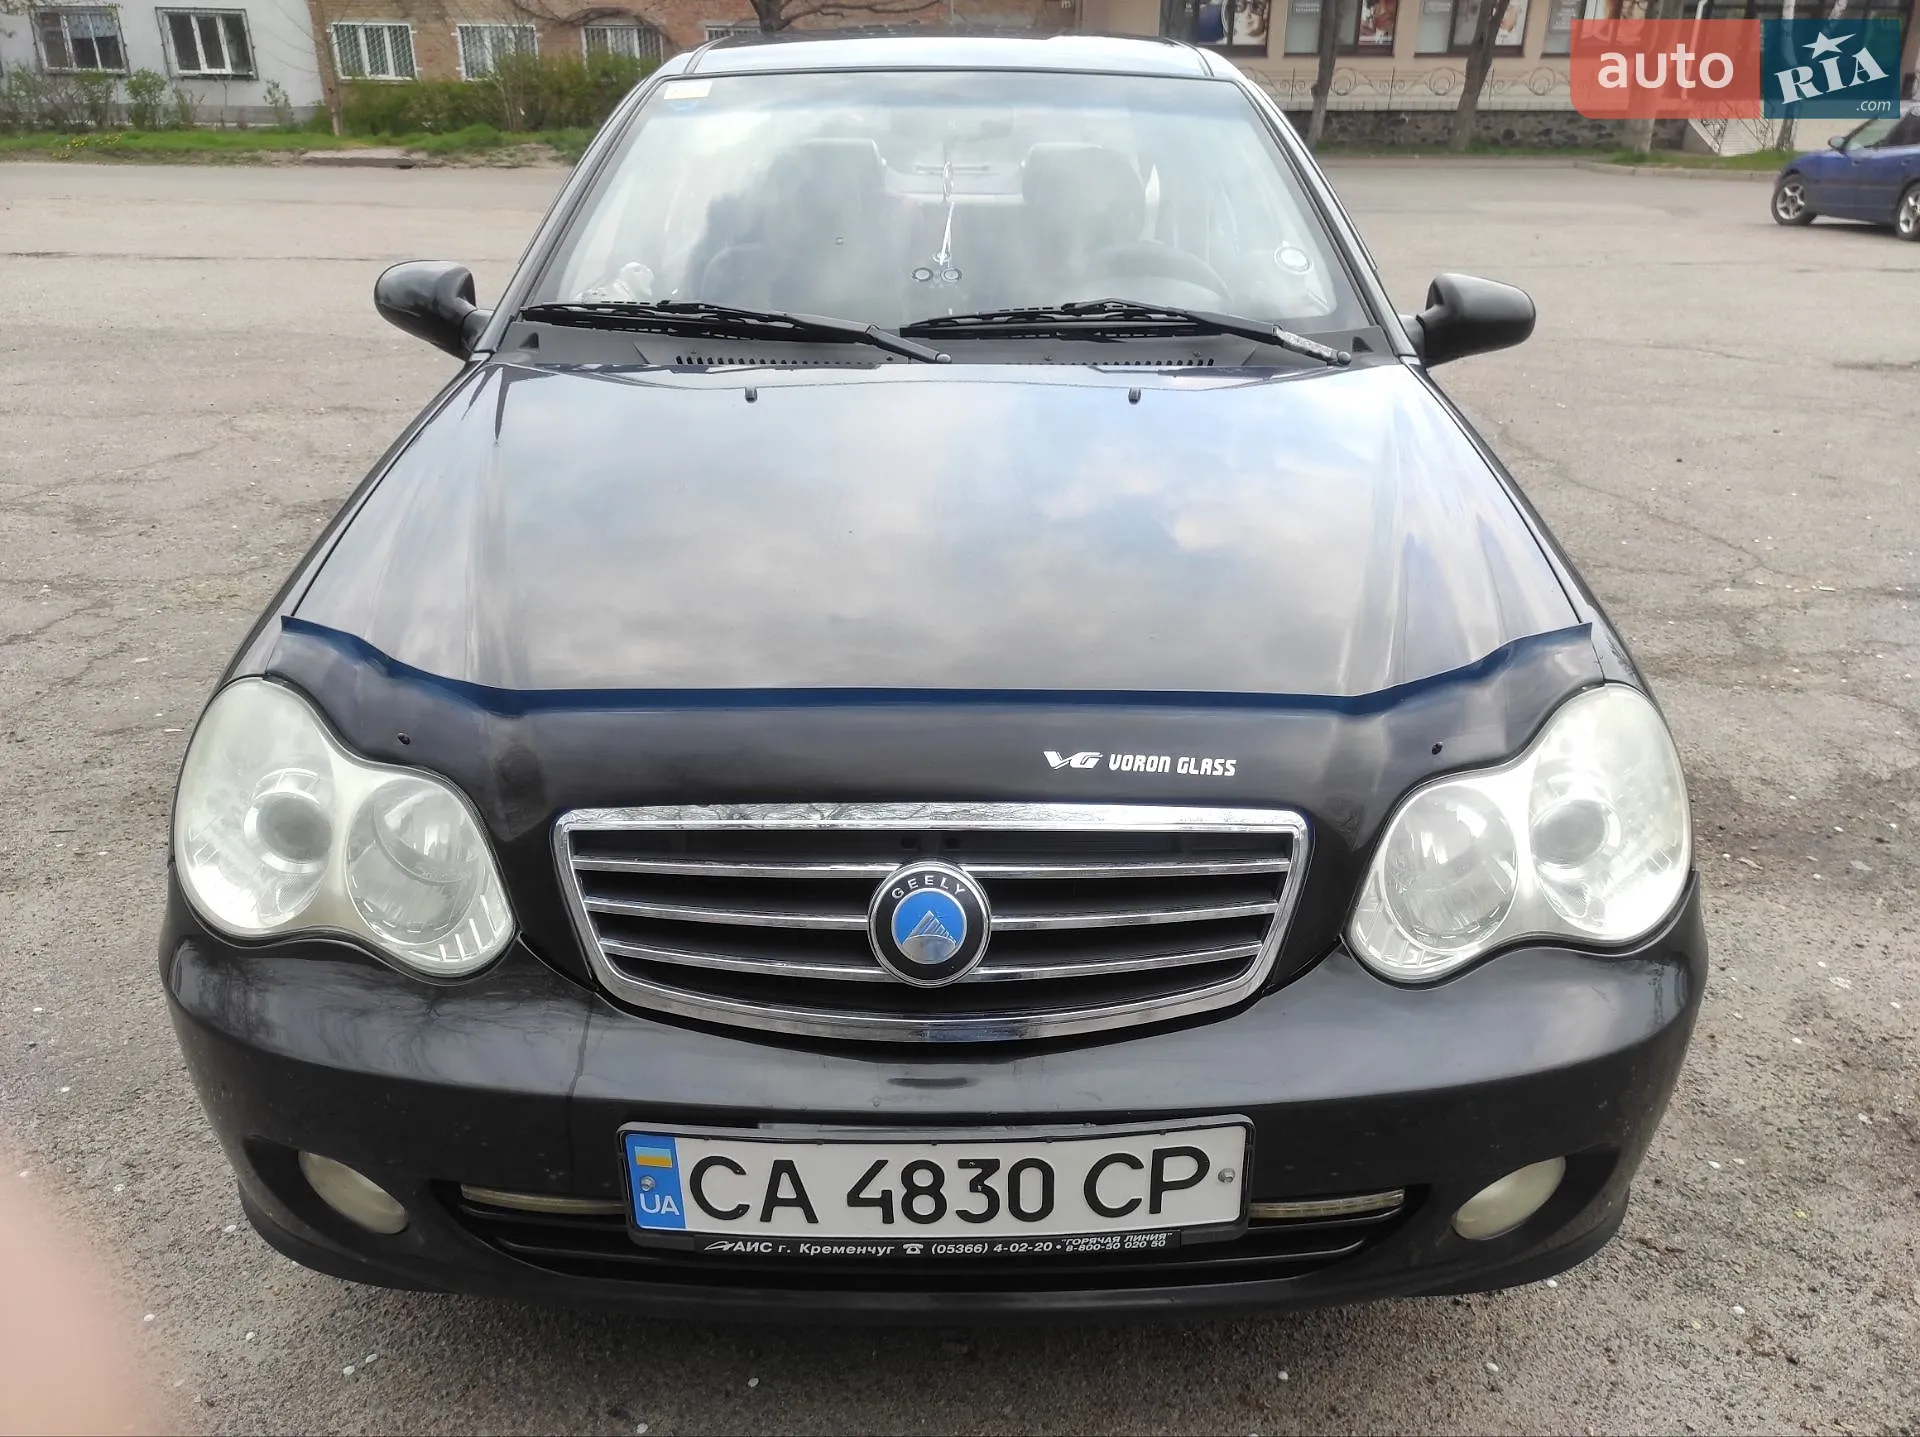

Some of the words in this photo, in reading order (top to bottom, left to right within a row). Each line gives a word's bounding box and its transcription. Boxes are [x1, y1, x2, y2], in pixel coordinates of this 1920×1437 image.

[1176, 756, 1237, 776] GLASS
[891, 875, 967, 900] GEELY
[689, 1155, 819, 1224] CA
[846, 1158, 1055, 1225] 4830
[1083, 1145, 1210, 1218] CP
[640, 1193, 680, 1216] UA
[799, 1243, 895, 1256] Кременчуг
[931, 1243, 988, 1255] (05366)
[993, 1242, 1053, 1253] 4-02-20
